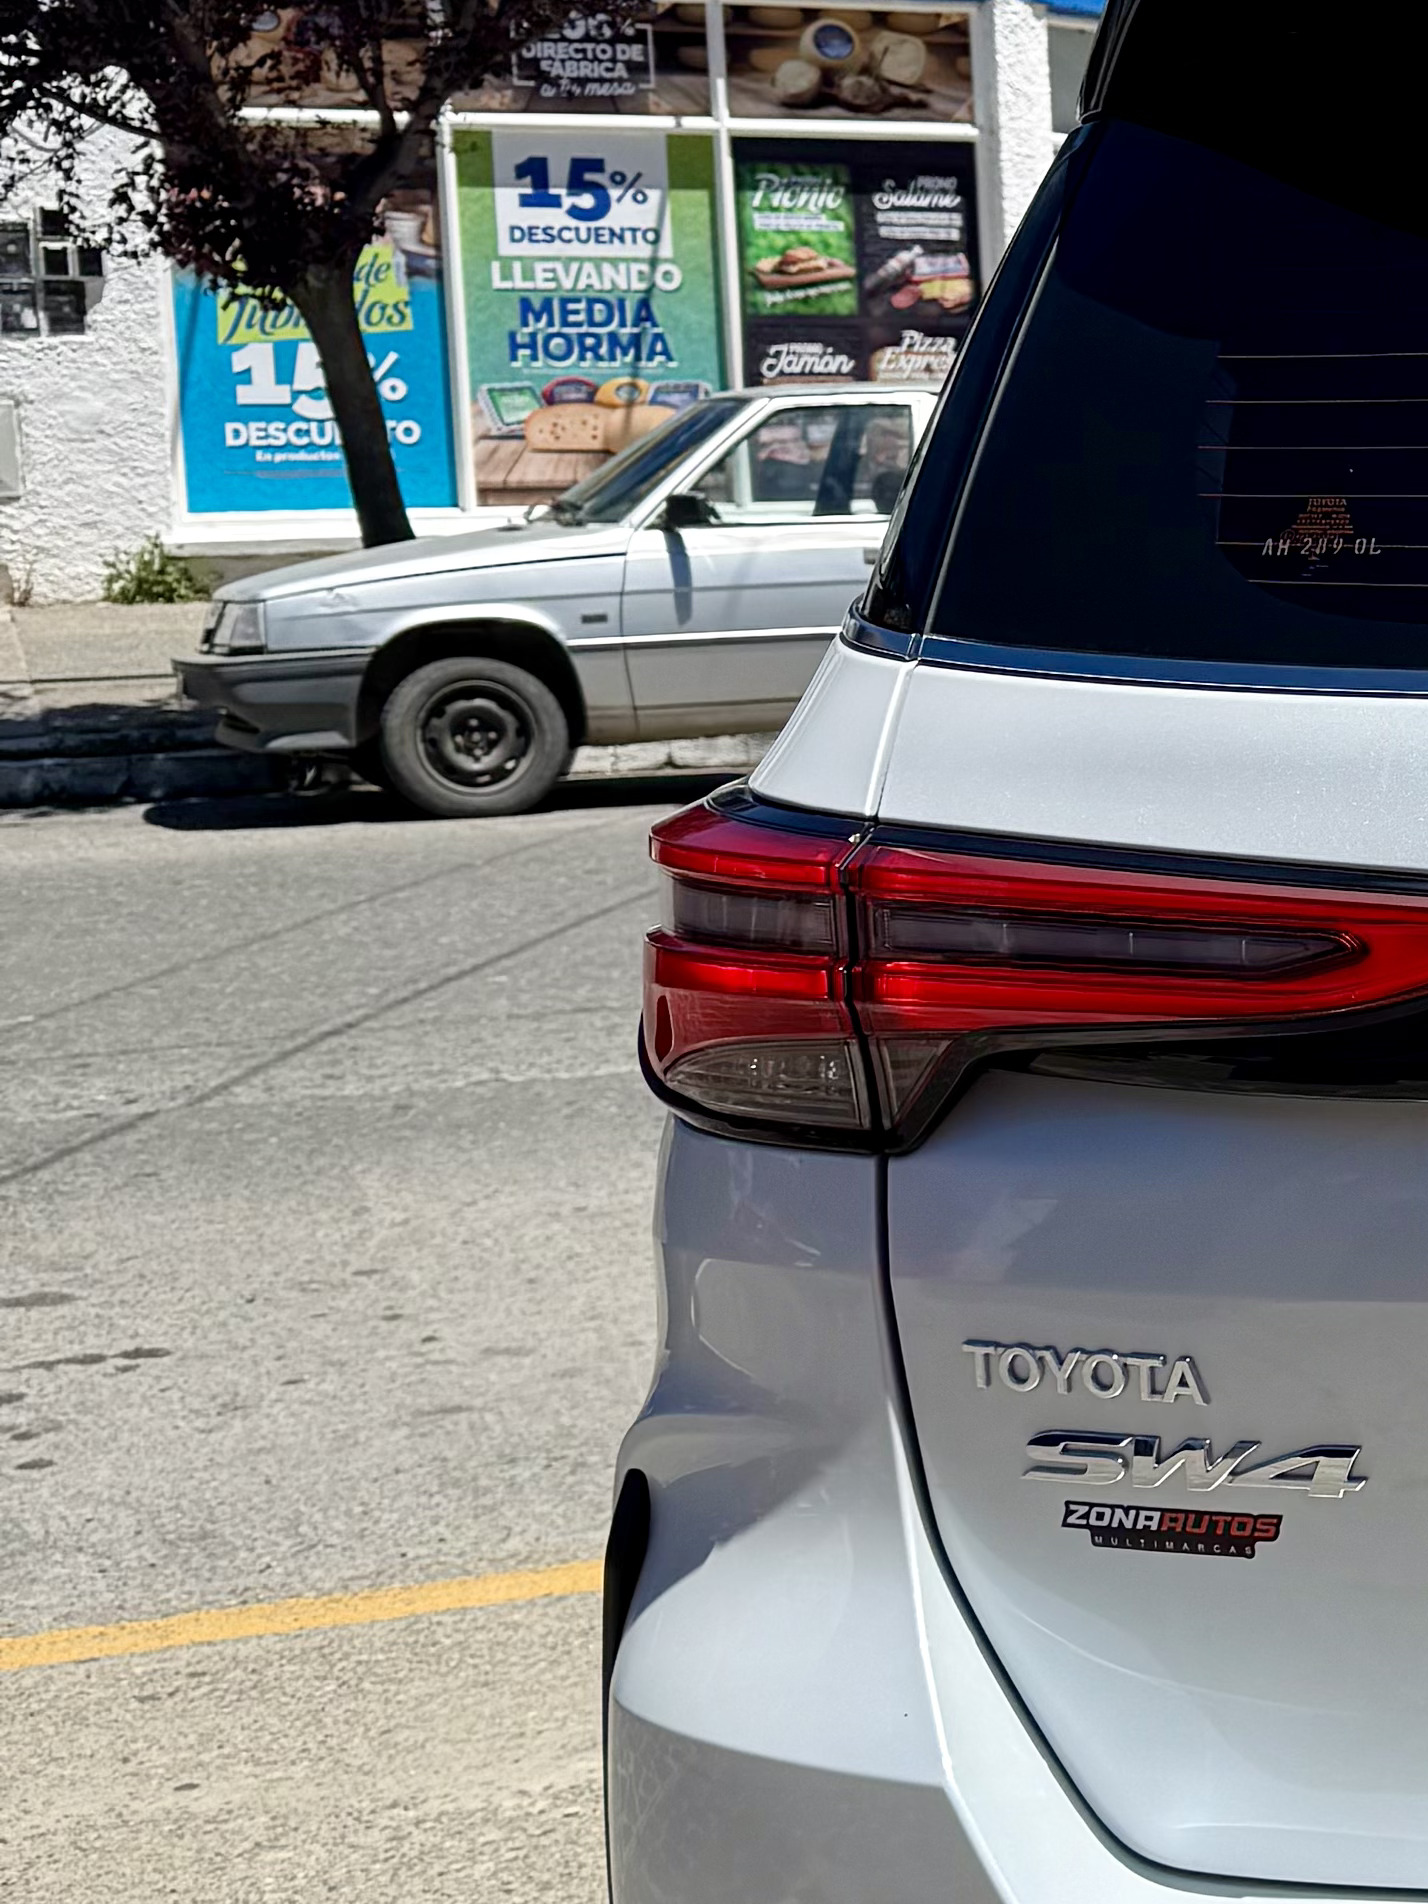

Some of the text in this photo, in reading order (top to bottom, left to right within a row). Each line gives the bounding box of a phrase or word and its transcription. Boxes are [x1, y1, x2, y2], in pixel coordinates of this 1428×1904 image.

[615, 44, 645, 61] DE
[514, 156, 648, 222] 15%
[752, 173, 845, 213] Picnic
[510, 225, 661, 245] DESCUENTO
[491, 261, 683, 292] LLEVANDO
[519, 297, 662, 333] MEDIA
[508, 332, 679, 368] HORMA
[760, 344, 856, 380] Jamón
[961, 1339, 1211, 1406] TOYOTA
[1020, 1429, 1369, 1499] SW4
[1094, 1535, 1254, 1557] MULTIMARCAS
